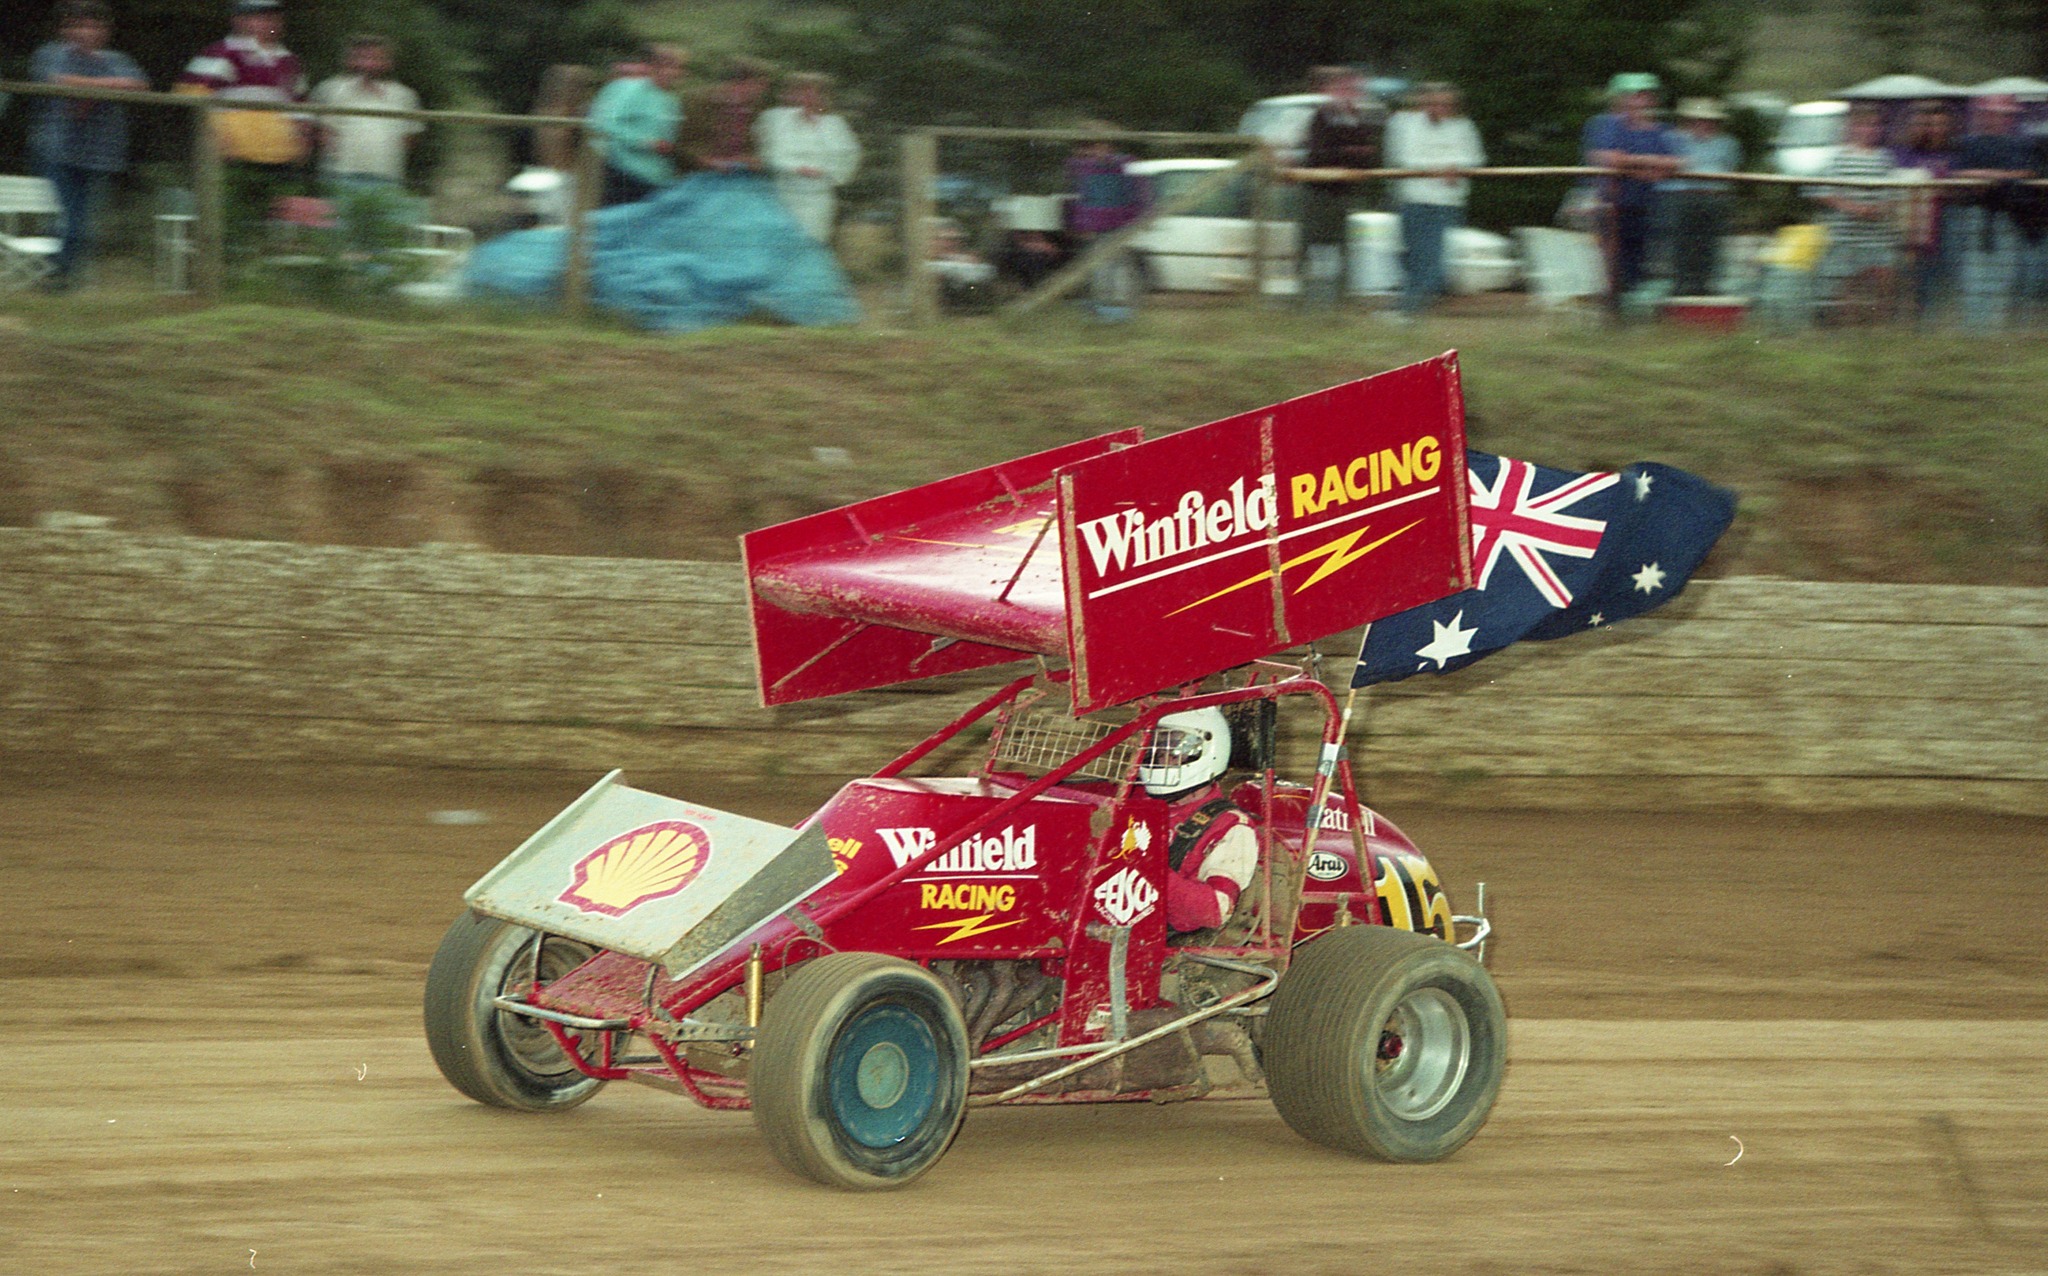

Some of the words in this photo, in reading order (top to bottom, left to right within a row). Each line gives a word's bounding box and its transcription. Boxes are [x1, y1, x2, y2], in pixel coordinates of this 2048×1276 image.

[1077, 473, 1279, 578] Winfield
[1291, 436, 1441, 519] RACING
[1307, 855, 1342, 871] Arai
[921, 884, 1016, 911] RACING
